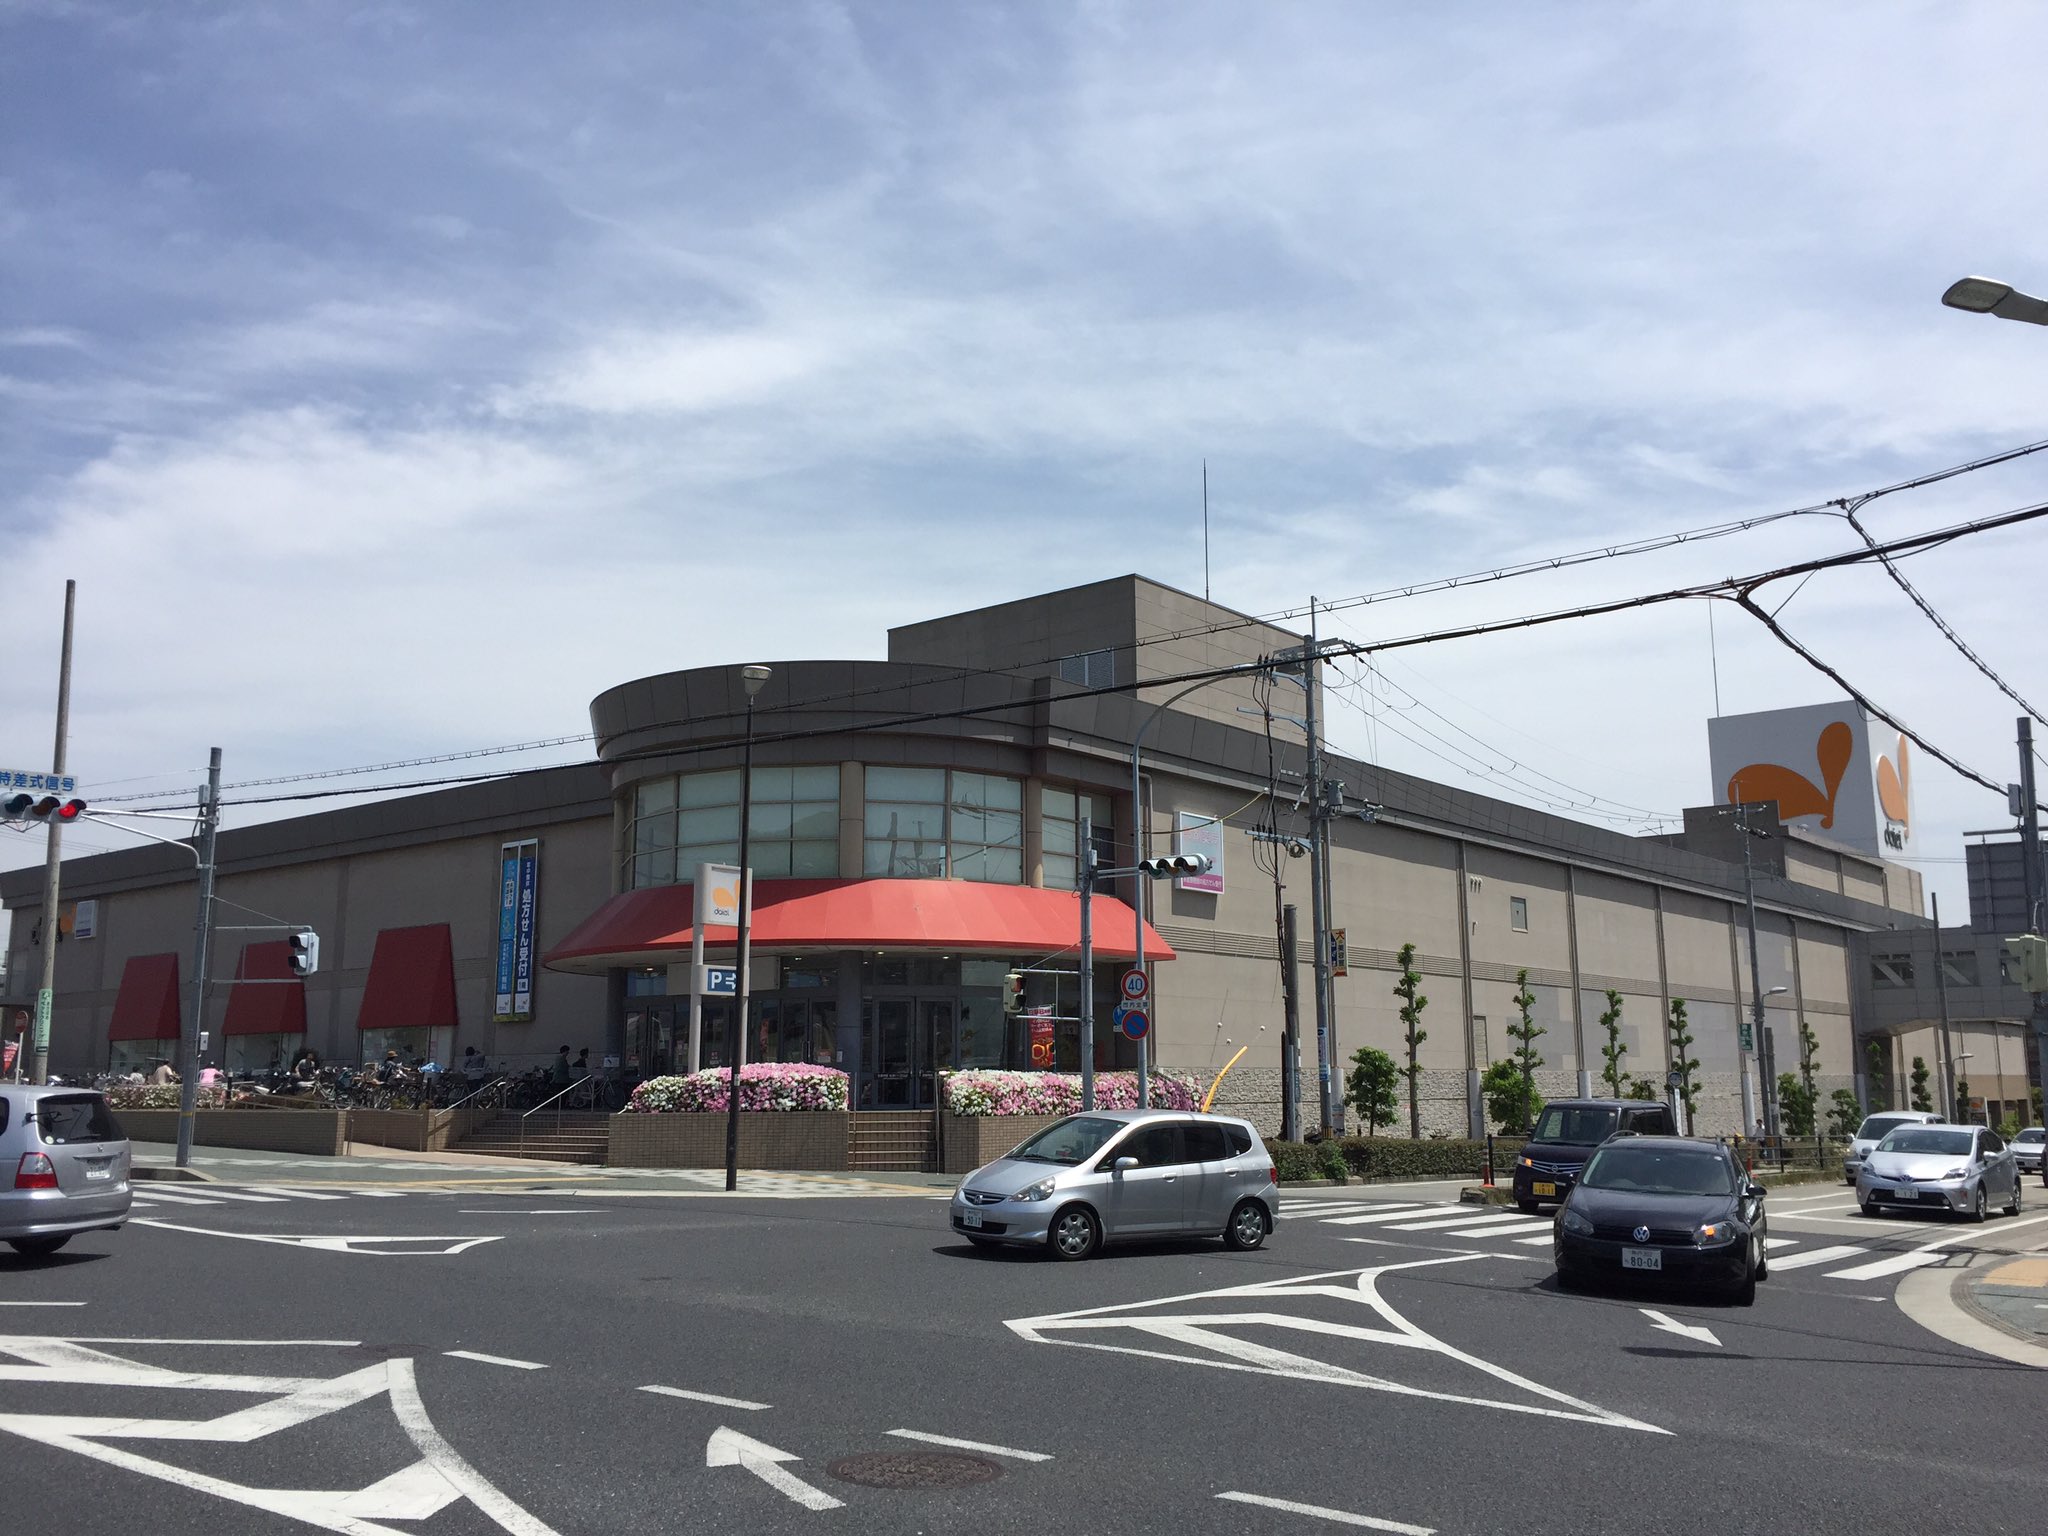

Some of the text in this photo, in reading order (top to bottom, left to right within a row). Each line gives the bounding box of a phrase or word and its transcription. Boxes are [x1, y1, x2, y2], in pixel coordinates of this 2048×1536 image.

[711, 971, 722, 989] P
[1128, 978, 1143, 992] 40
[1631, 1256, 1659, 1269] 80-04
